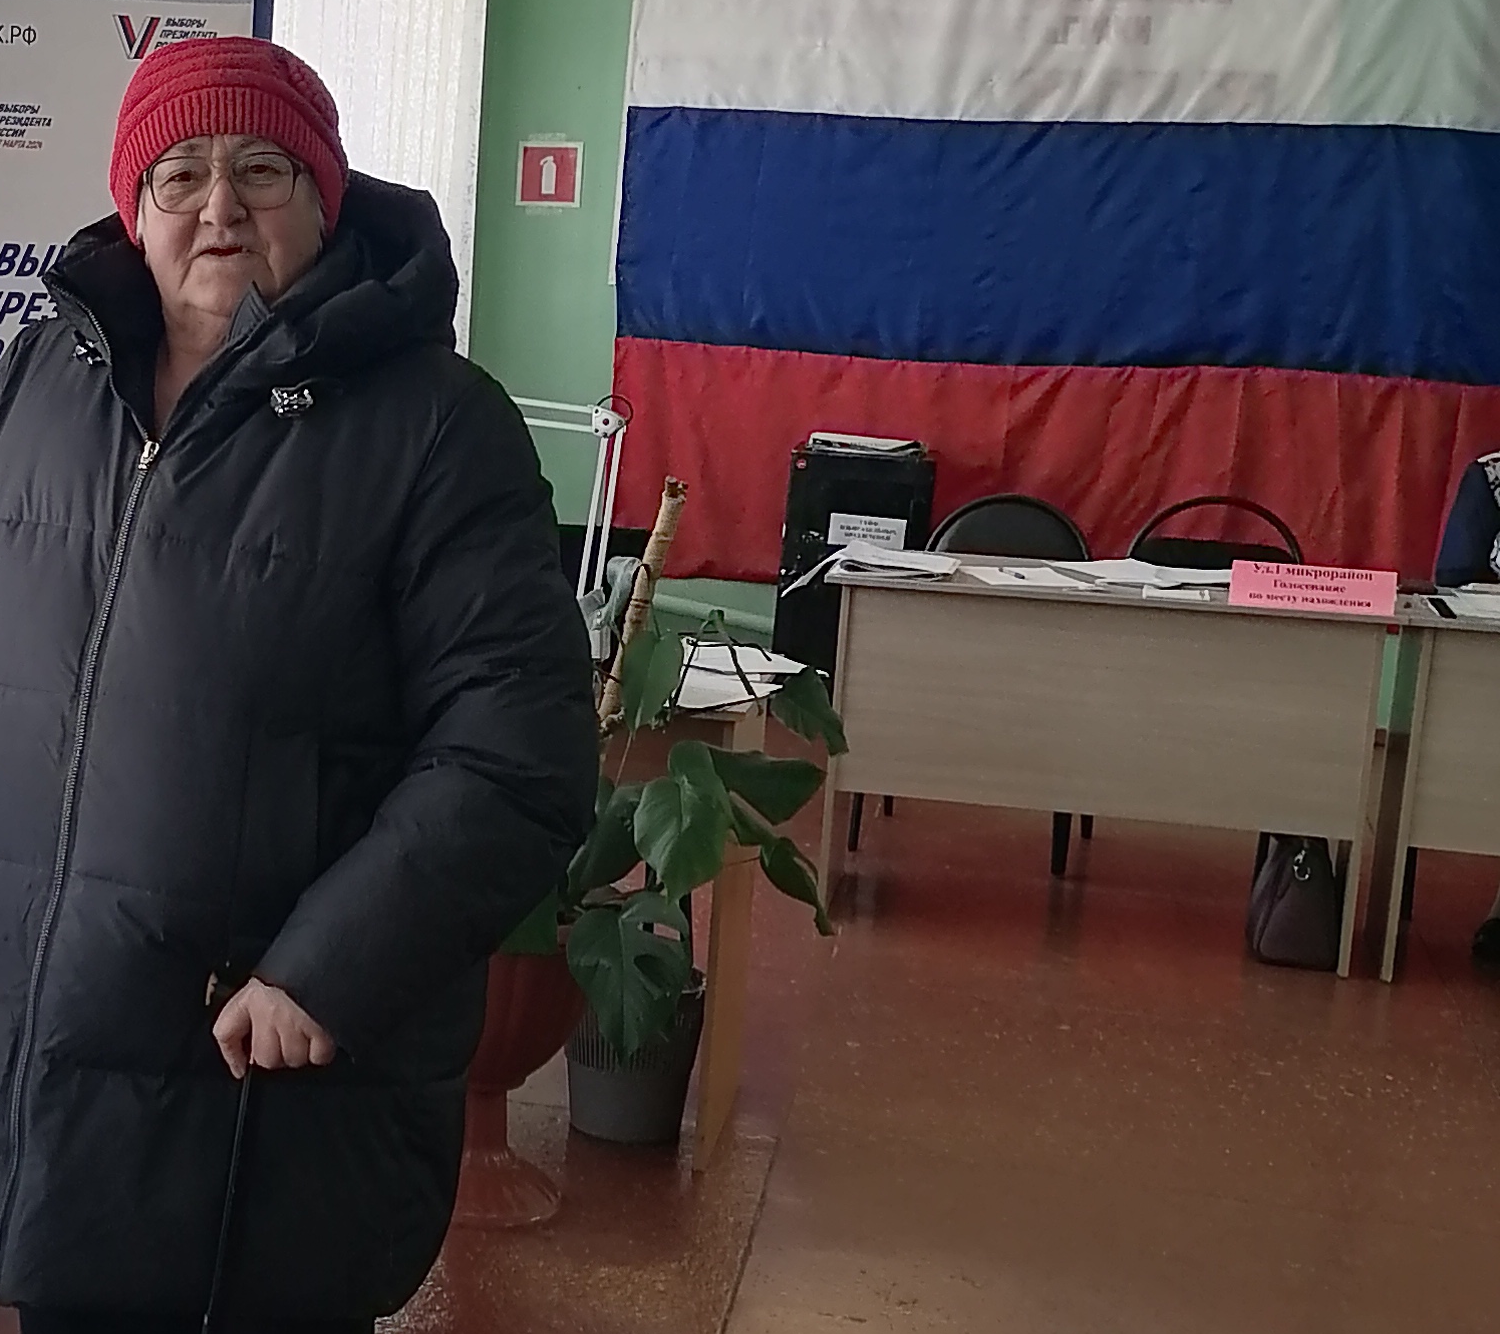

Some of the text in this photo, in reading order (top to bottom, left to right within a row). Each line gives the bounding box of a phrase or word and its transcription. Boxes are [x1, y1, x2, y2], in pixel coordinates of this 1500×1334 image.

[164, 17, 207, 28] ВЫБОРЫ
[159, 29, 218, 39] ПРЕЗИДЕНТА
[1285, 566, 1373, 581] микрорайон
[1273, 579, 1347, 593] Голосование
